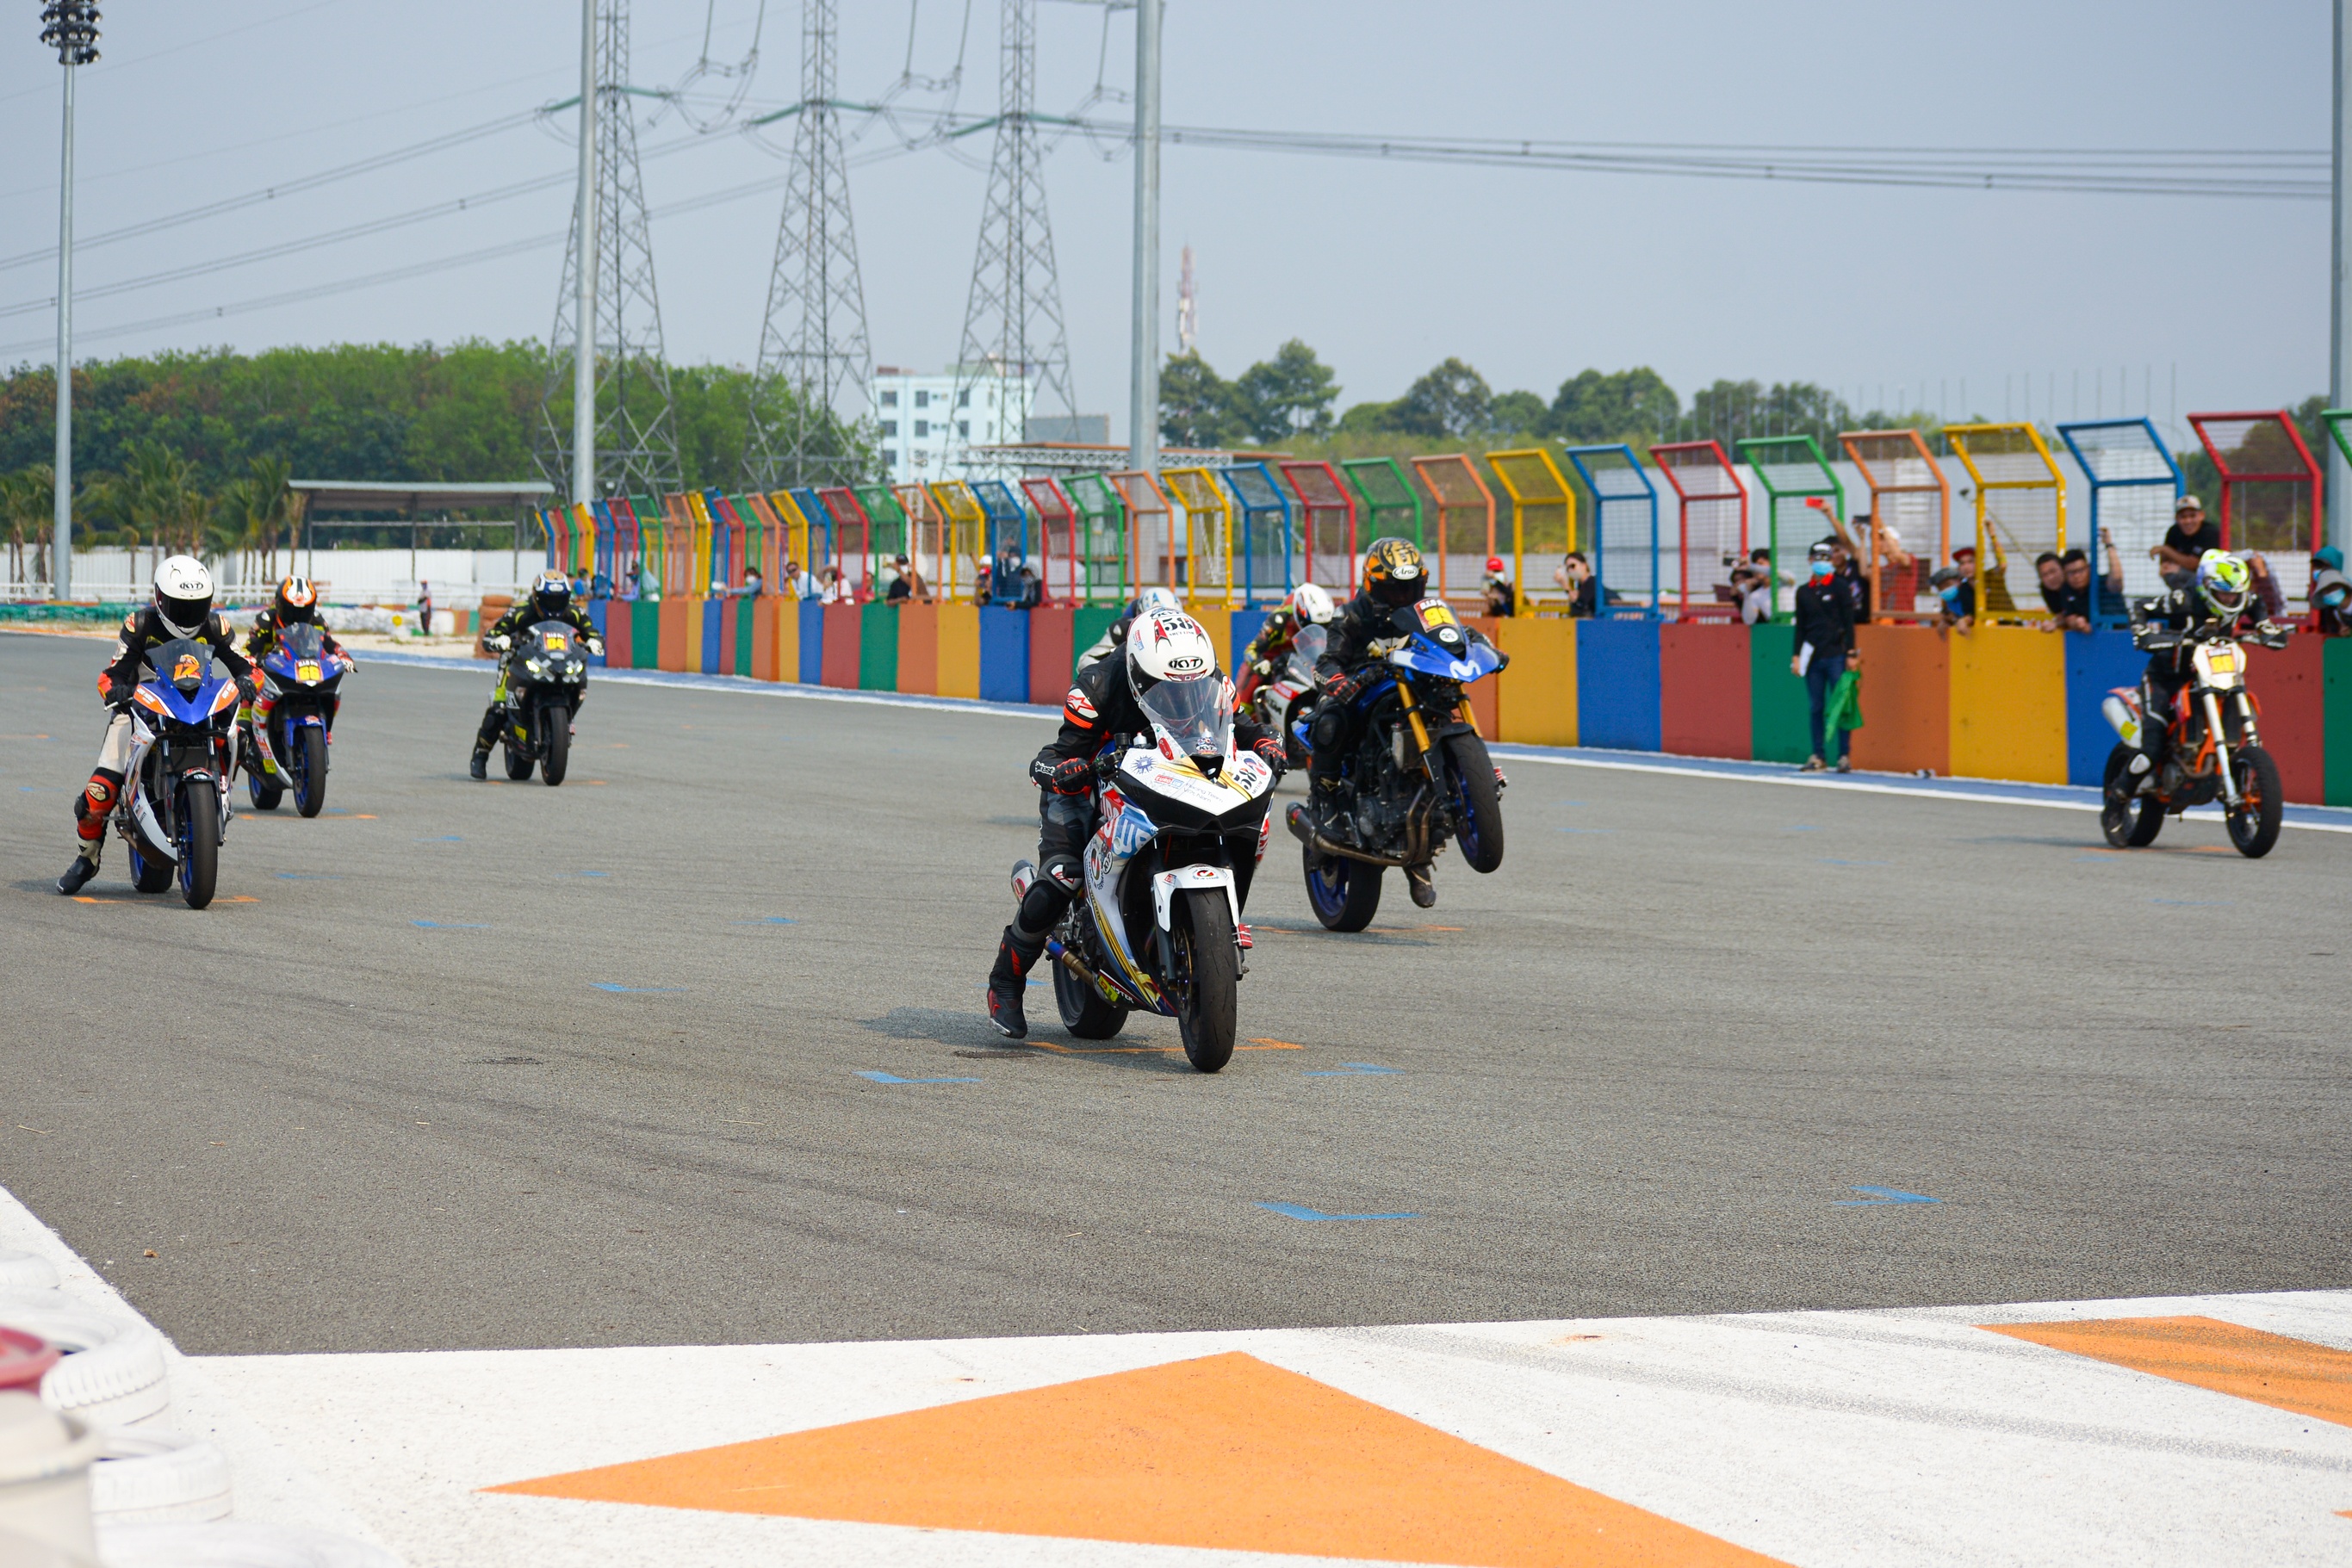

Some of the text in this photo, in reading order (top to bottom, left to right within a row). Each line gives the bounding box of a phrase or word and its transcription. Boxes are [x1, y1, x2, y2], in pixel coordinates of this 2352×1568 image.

[1394, 567, 1415, 577] Arai
[182, 581, 202, 591] KYT
[1424, 607, 1455, 628] 99
[1163, 618, 1194, 632] 58
[1172, 658, 1202, 668] KYT
[1233, 768, 1257, 790] 58
